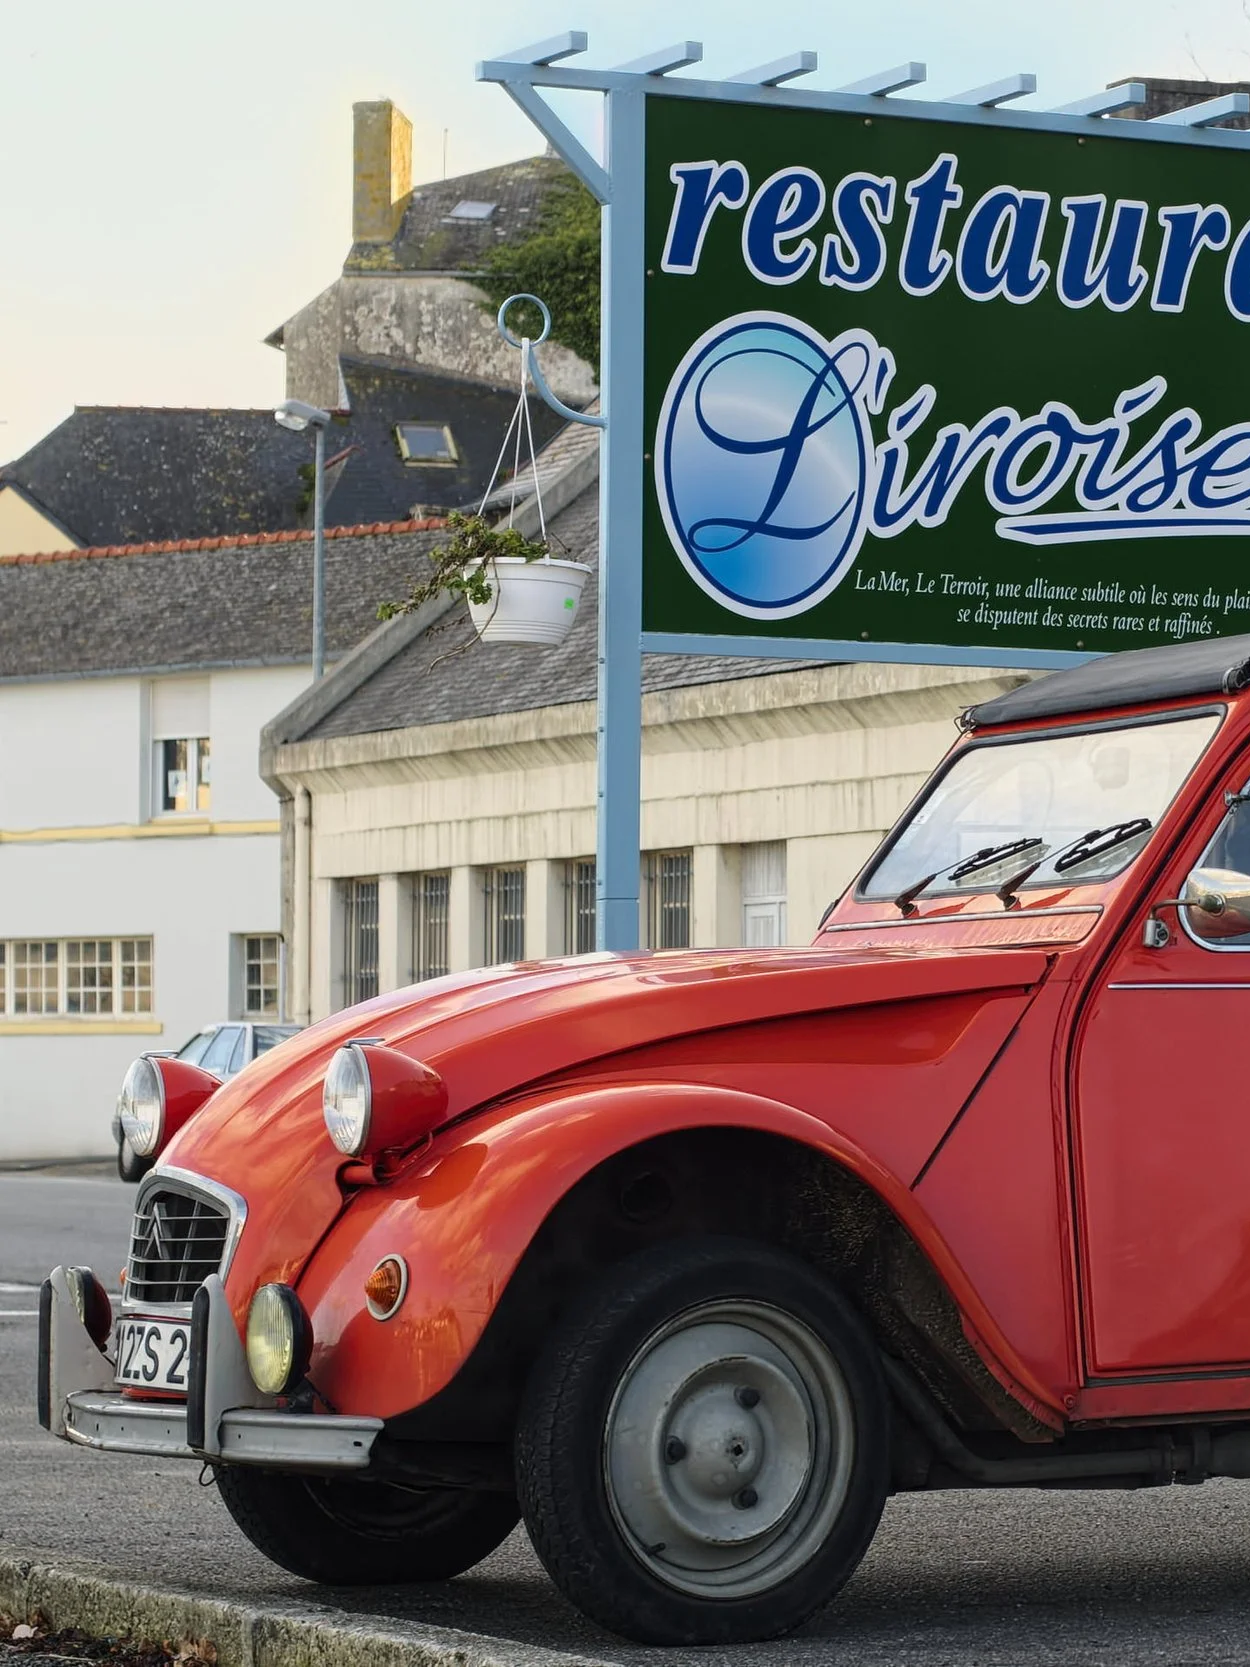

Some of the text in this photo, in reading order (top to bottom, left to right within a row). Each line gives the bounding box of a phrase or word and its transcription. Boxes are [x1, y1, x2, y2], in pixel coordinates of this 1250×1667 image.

[915, 572, 935, 594] Le
[940, 573, 990, 601] Terroir,
[995, 583, 1022, 598] une
[1025, 577, 1078, 601] alliance
[1080, 581, 1126, 603] subtile
[1129, 585, 1147, 605] où
[1150, 585, 1168, 606] les
[1171, 592, 1200, 607] sens
[1203, 588, 1220, 608] du
[956, 608, 970, 623] se
[974, 603, 1039, 631] disputent
[1042, 606, 1064, 628] des
[1066, 611, 1109, 630] secrets
[1112, 616, 1145, 632] rares
[1148, 614, 1160, 632] et
[166, 1328, 191, 1385] 2
